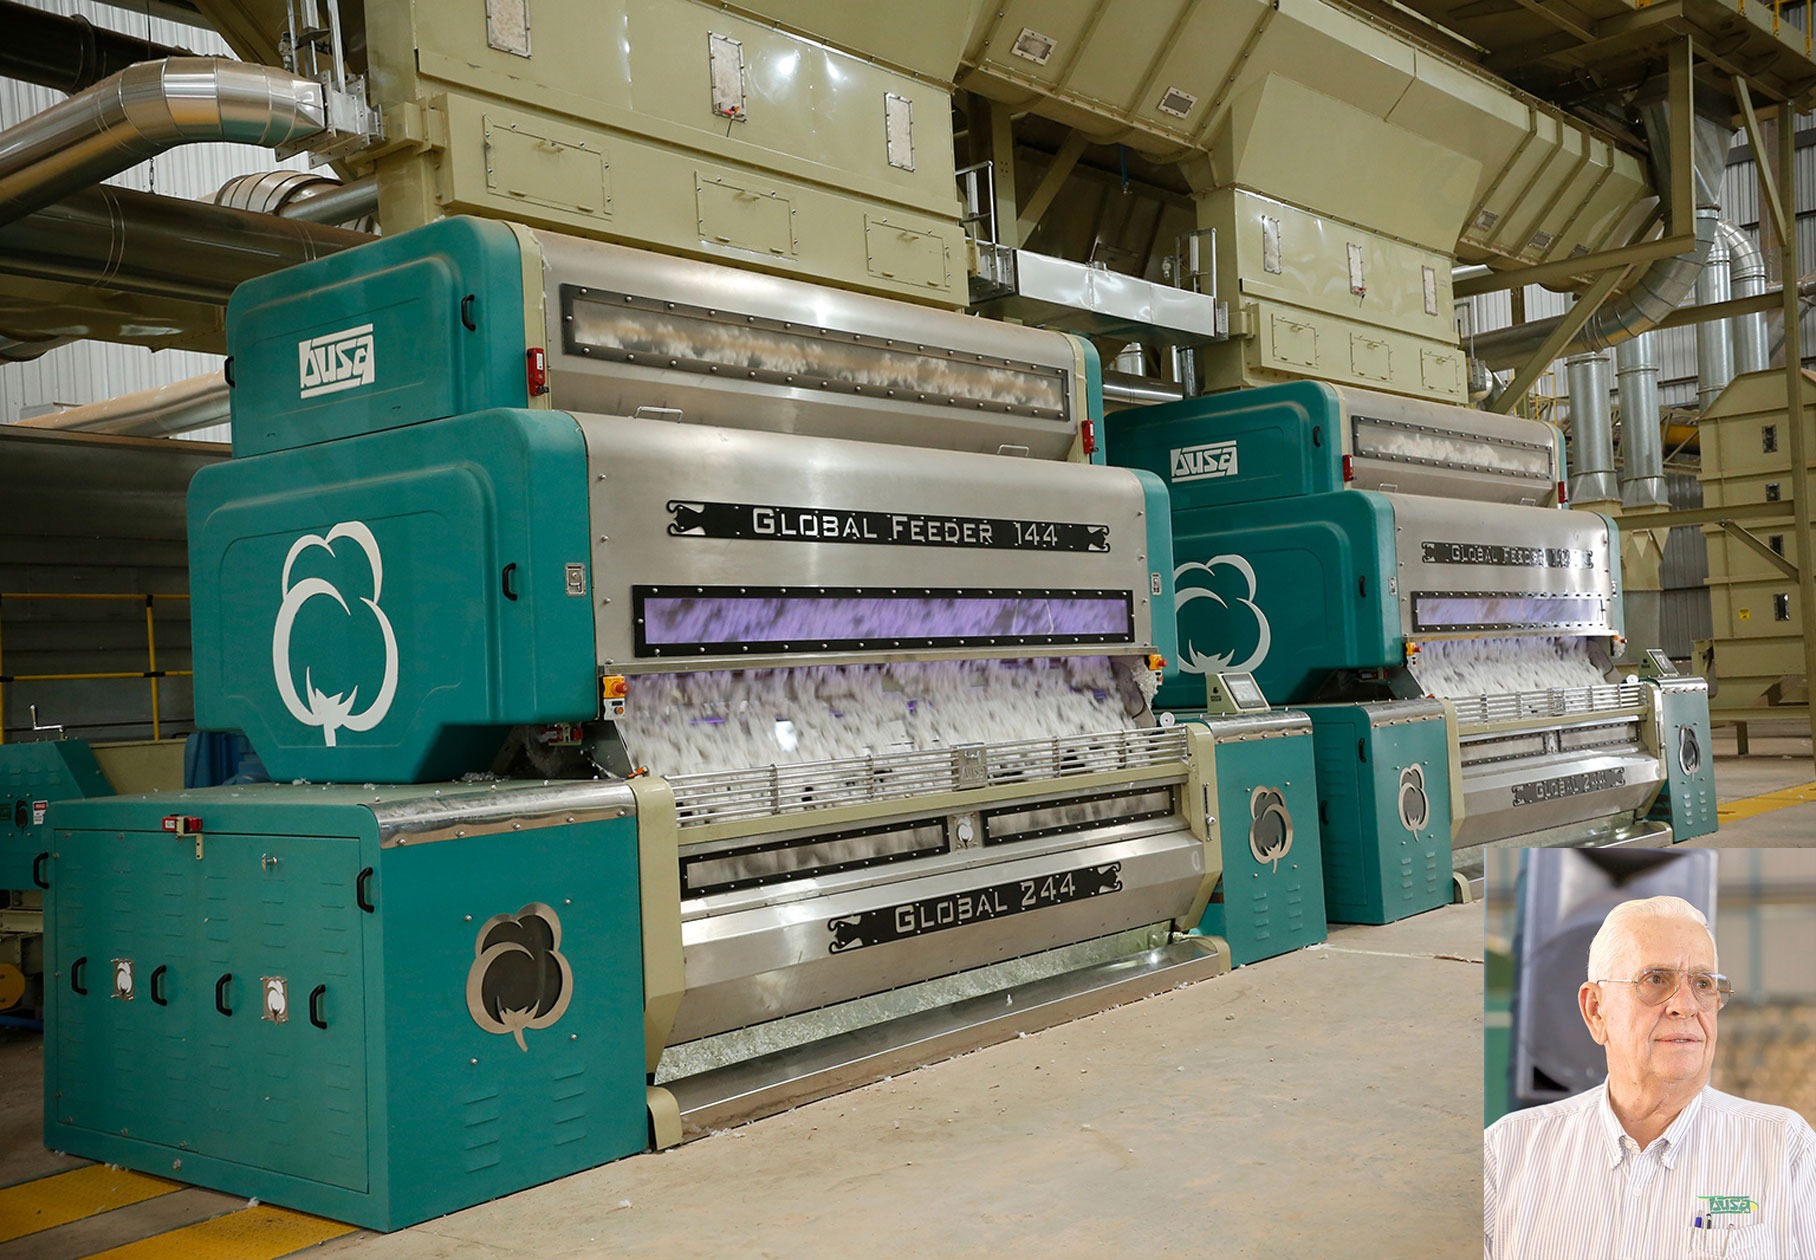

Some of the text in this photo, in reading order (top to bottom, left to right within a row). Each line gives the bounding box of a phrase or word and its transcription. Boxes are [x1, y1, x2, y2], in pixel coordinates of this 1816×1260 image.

[752, 508, 1058, 547] GLOBAL FEEDER 144
[894, 872, 1077, 934] GLOBAL 244
